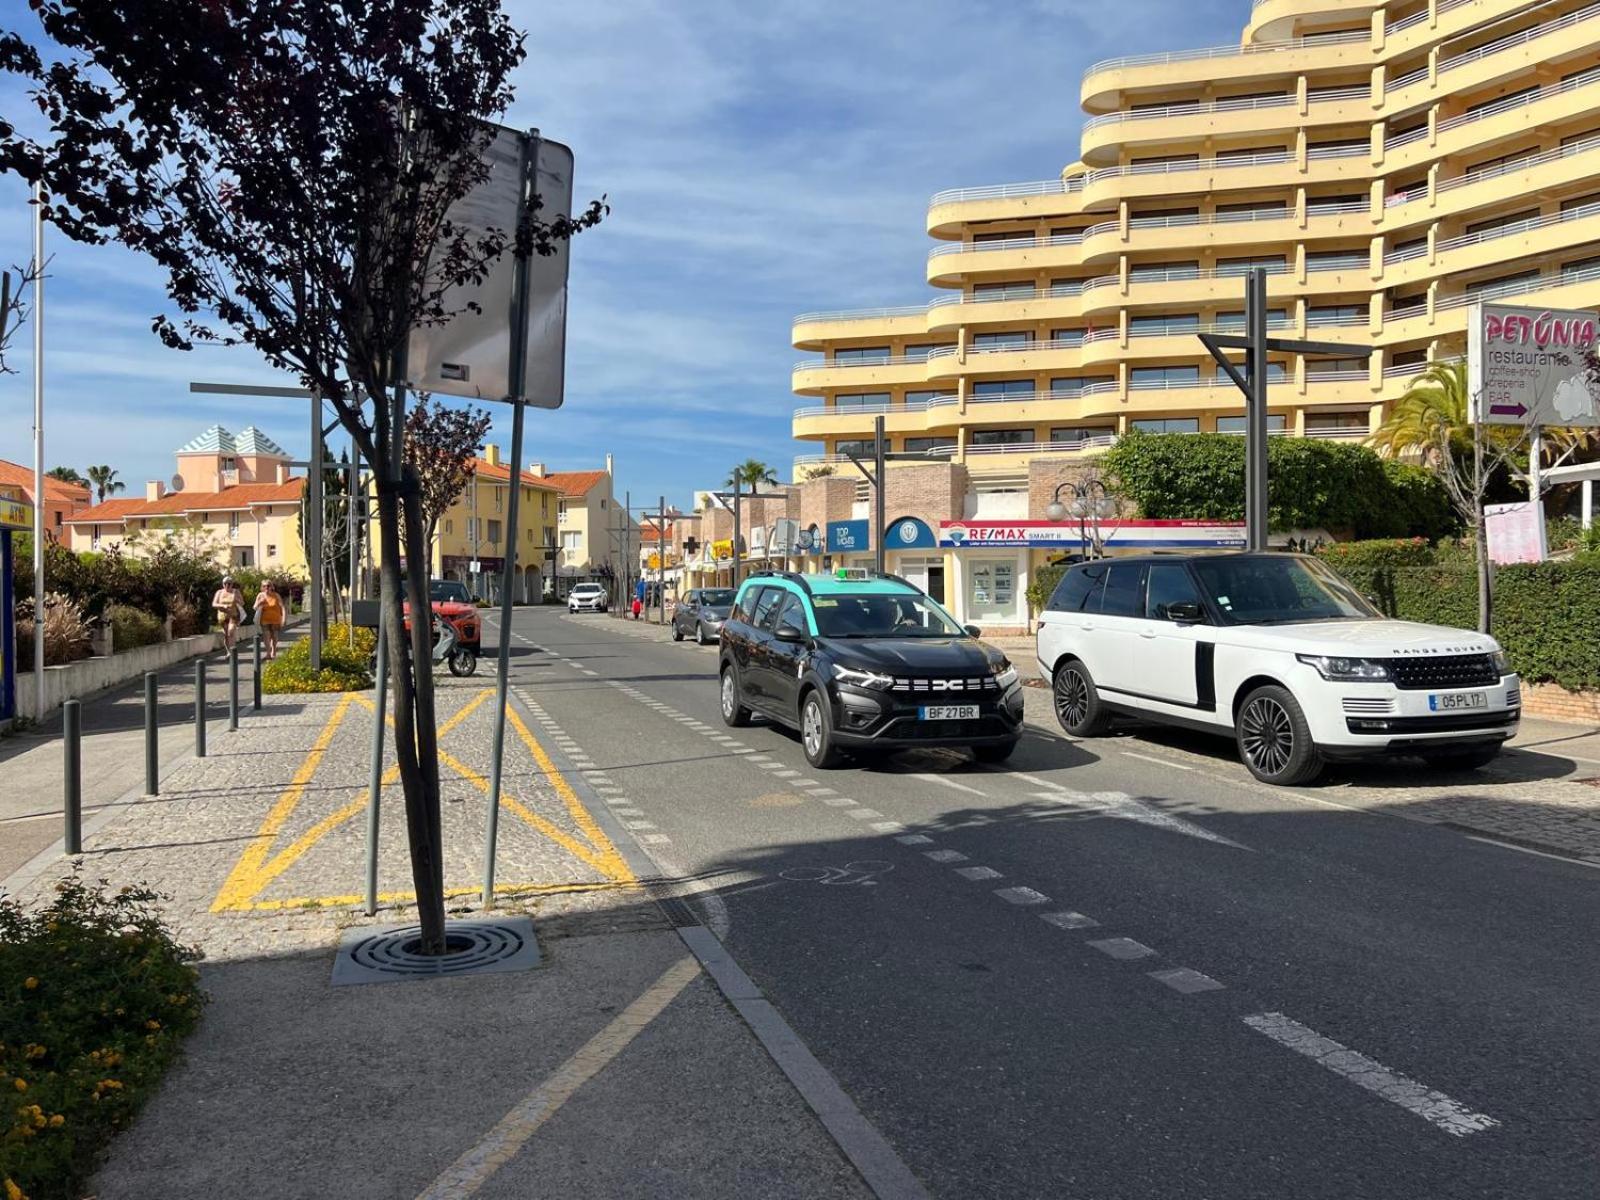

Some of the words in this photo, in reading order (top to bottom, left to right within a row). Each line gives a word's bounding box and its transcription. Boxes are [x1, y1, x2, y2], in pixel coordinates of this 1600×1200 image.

[1484, 311, 1595, 347] PETÚNIA
[1488, 348, 1570, 366] restaurane
[969, 528, 1026, 540] RE/MAX
